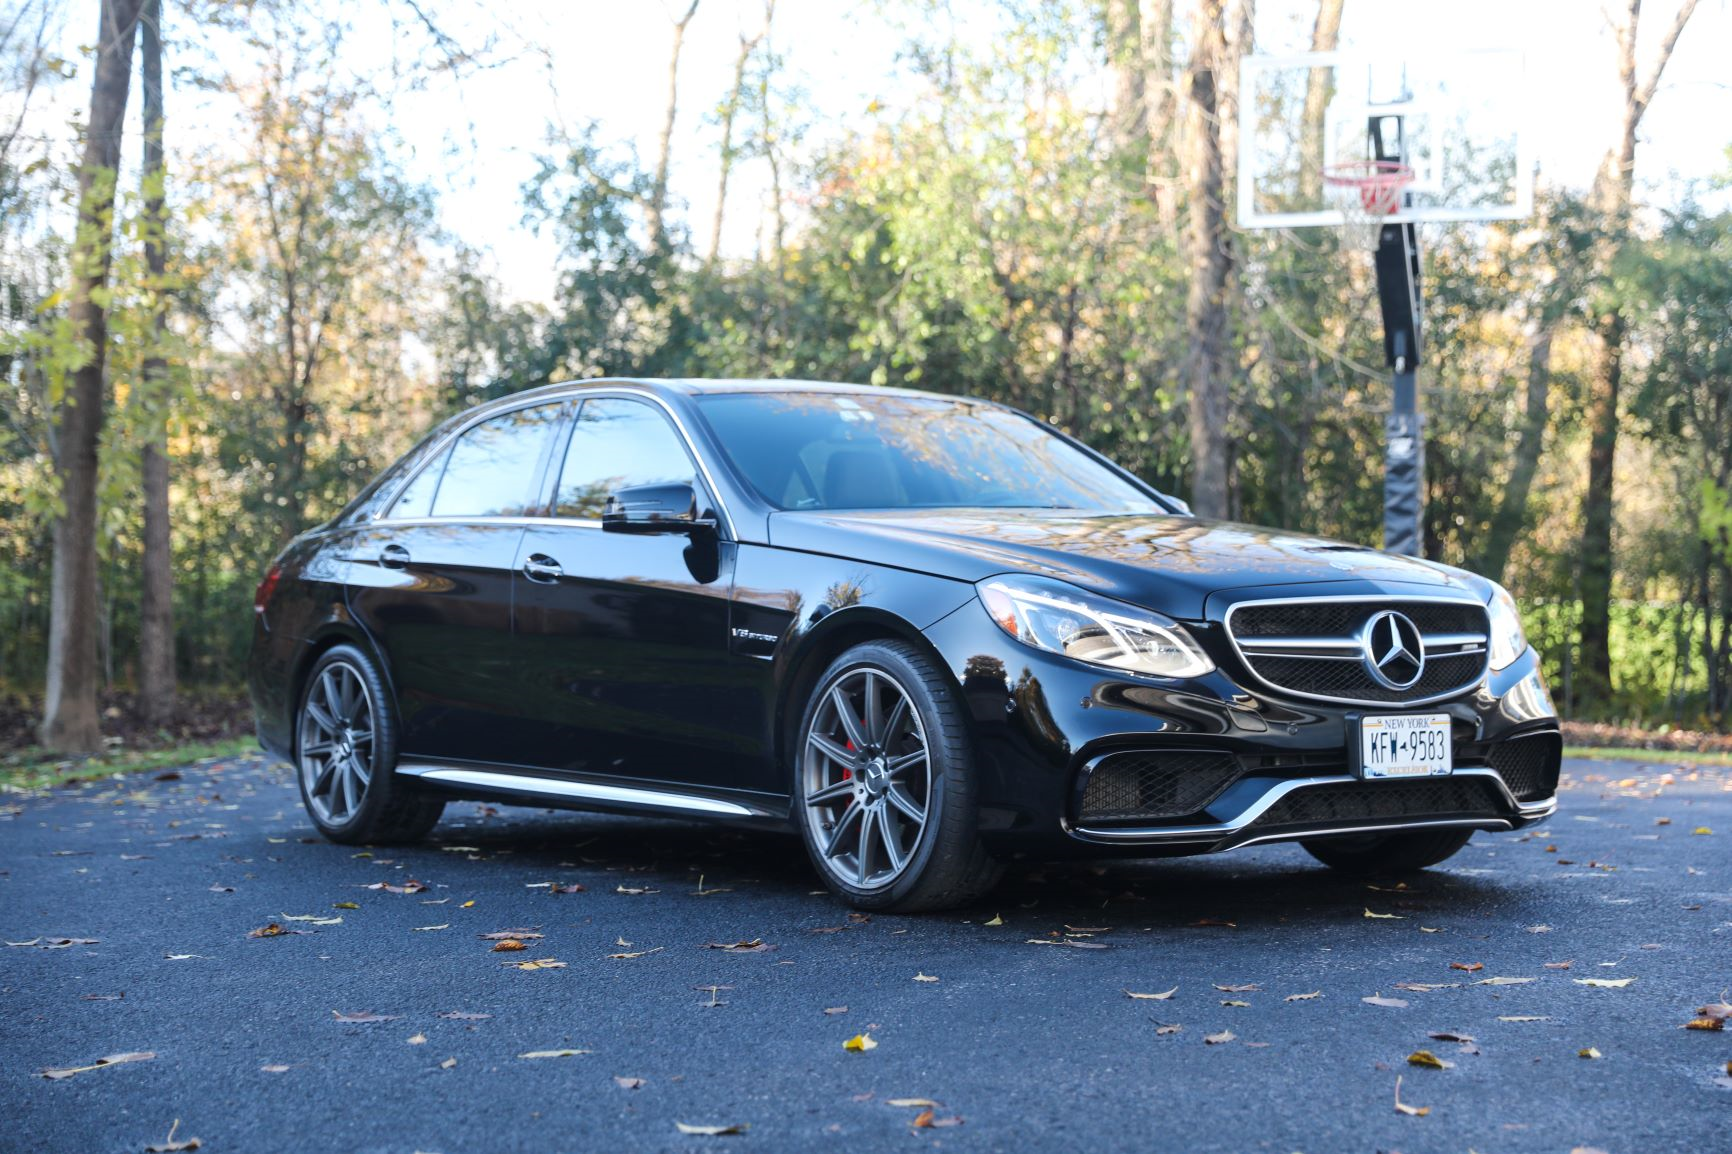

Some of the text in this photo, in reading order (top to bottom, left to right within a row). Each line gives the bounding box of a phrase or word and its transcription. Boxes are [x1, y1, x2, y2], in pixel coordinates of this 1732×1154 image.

[731, 627, 749, 637] V8
[1385, 718, 1430, 730] NEW YORK
[1410, 730, 1445, 760] 9583
